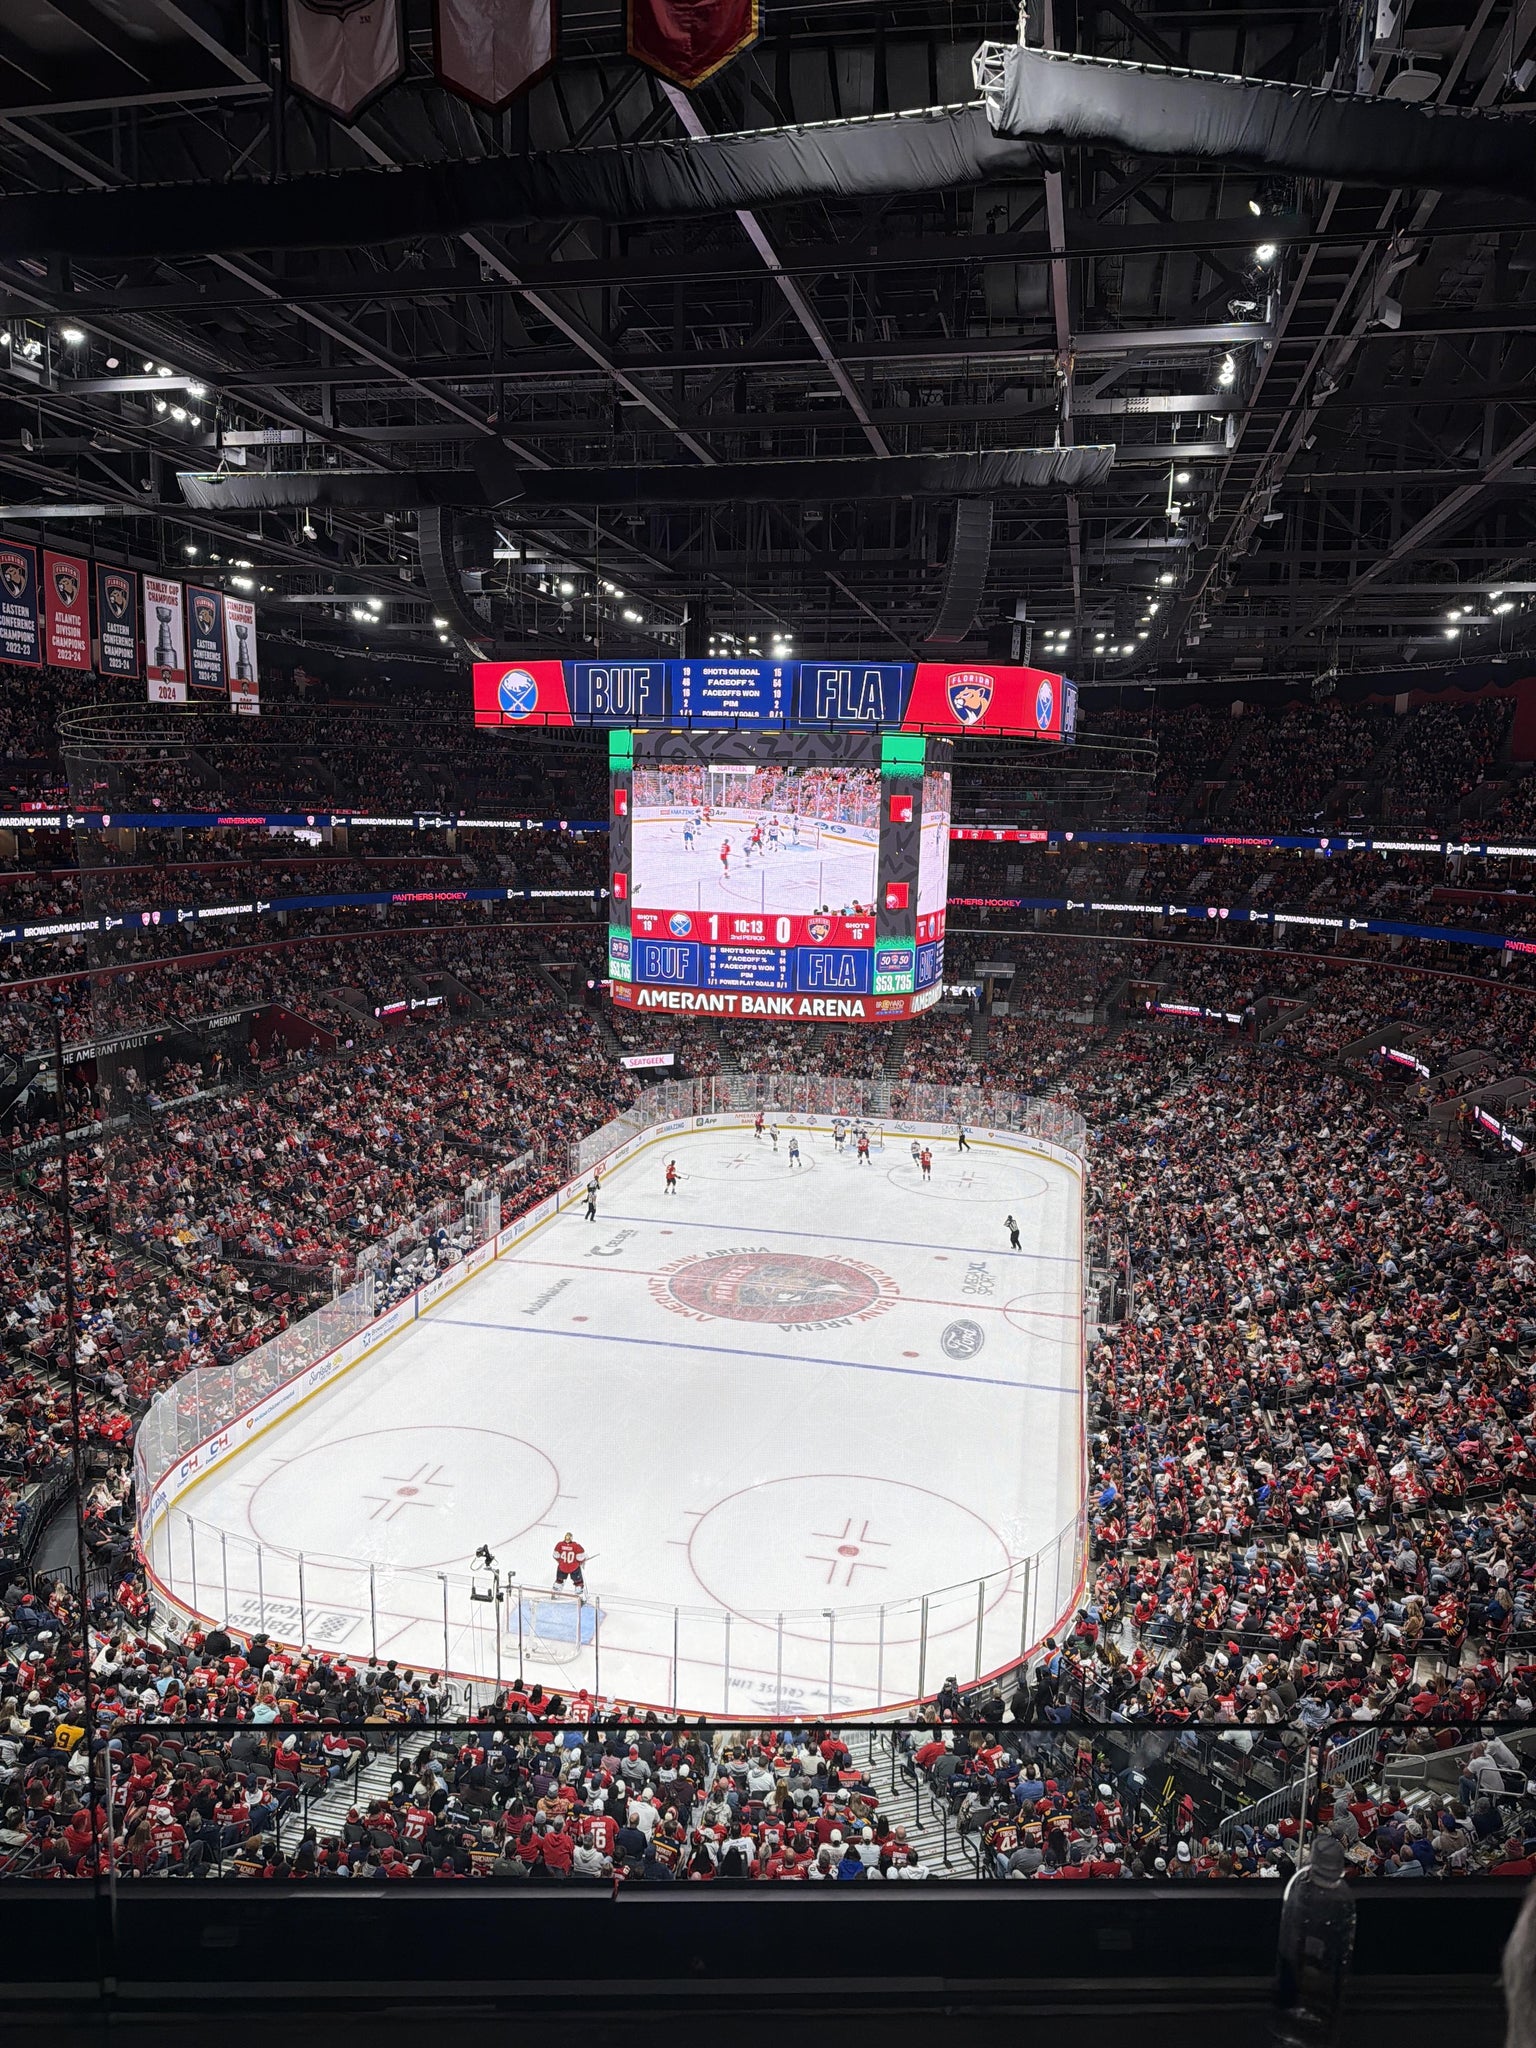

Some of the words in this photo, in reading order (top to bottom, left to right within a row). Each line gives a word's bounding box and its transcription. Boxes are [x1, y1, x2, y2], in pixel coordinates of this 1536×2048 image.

[146, 580, 167, 593] STANLEY
[168, 584, 179, 594] CUP
[148, 591, 178, 606] CHAMPIONS
[2, 603, 30, 618] EASTERN
[0, 614, 36, 632] CONFERENCE
[54, 611, 81, 626] ATLANTIC
[0, 628, 35, 644] CHAMPIONS
[55, 624, 81, 638] DIVISION
[107, 623, 130, 635] EASTERN
[51, 636, 86, 651] CHAMPIONS
[103, 633, 135, 648] CONFERENCE
[197, 638, 217, 651] EASTERN
[5, 643, 31, 656] 2022-23
[57, 649, 81, 662] 2023-24
[104, 645, 133, 659] CHAMPIONS
[193, 649, 222, 662] CONFERENCE
[109, 657, 130, 670] 2023-24
[194, 658, 221, 672] CHAMPIONS
[198, 670, 218, 682] 2024-25
[703, 668, 728, 676] SHOTS
[774, 668, 782, 677] 15
[951, 673, 990, 686] FLORIDA
[158, 686, 176, 700] 2024
[589, 668, 650, 715] BUF
[817, 670, 884, 720] FLA
[684, 699, 688, 707] 2
[774, 701, 779, 709] 2
[43, 817, 60, 826] DADE
[397, 818, 413, 826] DADE
[1203, 837, 1240, 845] PANTHERS
[1242, 838, 1273, 846] HOCKEY
[392, 893, 433, 901] PANTHERS
[435, 892, 467, 900] HOCKEY
[985, 899, 1021, 907] HOCKEY
[239, 905, 252, 914] DADE
[1092, 903, 1145, 912] BROWARD/MIAMI
[1146, 905, 1163, 913] DADE
[709, 914, 718, 941] 1
[735, 919, 763, 934] 10:13
[1275, 914, 1325, 926] BROWARD/MIAMI
[1326, 919, 1343, 927] DADE
[24, 923, 81, 937] BROWARD/MIAMI
[81, 921, 99, 930] DADE
[776, 916, 790, 943] 0
[852, 929, 862, 940] 15
[646, 946, 689, 979] BUF
[881, 956, 890, 965] 50
[899, 955, 908, 964] 50
[809, 954, 856, 986] FLA
[876, 975, 911, 992] $53,735
[637, 989, 738, 1012] AMERANT
[741, 996, 794, 1016] BANK
[798, 998, 865, 1017] ARENA
[208, 1014, 241, 1030] AMERANT
[76, 1043, 118, 1063] AMERANT
[120, 1035, 148, 1050] VAULT
[629, 1057, 665, 1067] SEATGEEK
[706, 1246, 771, 1258] ARENA
[659, 1254, 704, 1273] BANK
[824, 1254, 900, 1295] AMERANT
[648, 1277, 715, 1322] AMERANT
[854, 1300, 897, 1322] BANK
[778, 1316, 853, 1333] ARENA
[947, 1323, 977, 1353] Ford
[210, 1433, 228, 1456] CH
[181, 1455, 198, 1479] CH
[561, 1551, 575, 1564] 40
[574, 1710, 590, 1723] 63
[58, 1732, 70, 1749] 9
